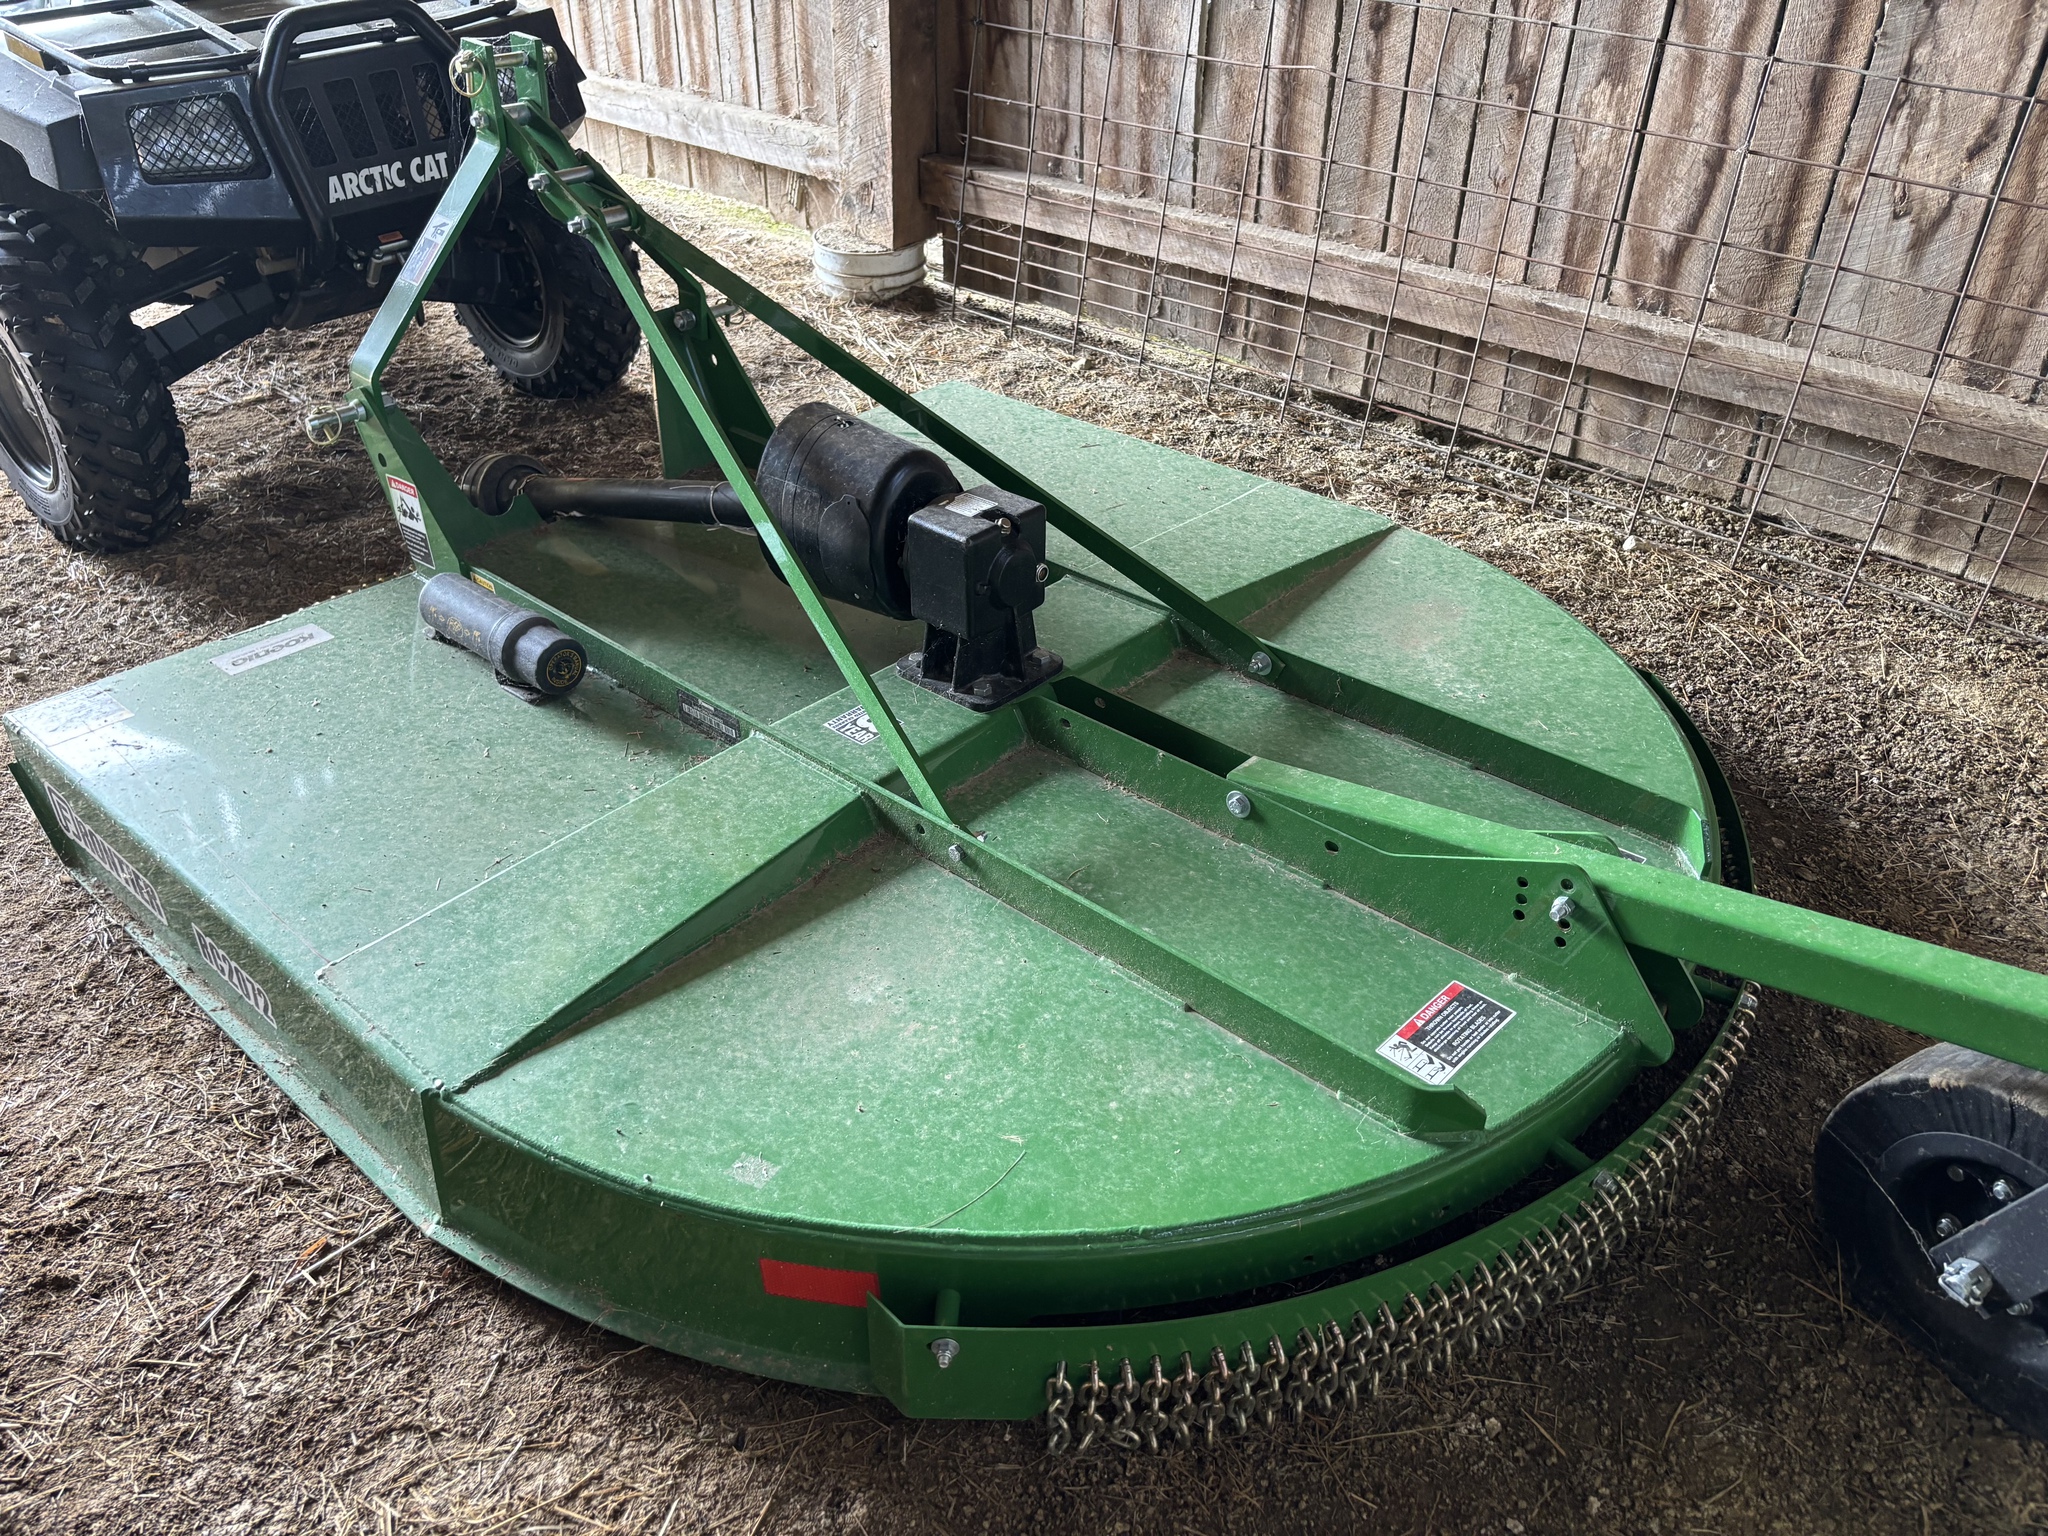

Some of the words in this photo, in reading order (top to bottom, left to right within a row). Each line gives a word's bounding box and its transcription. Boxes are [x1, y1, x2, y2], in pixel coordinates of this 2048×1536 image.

[328, 161, 406, 204] ARCTIC
[409, 151, 449, 184] CAT
[839, 721, 875, 743] YEAR
[48, 784, 166, 922] FRONTIER
[195, 928, 277, 1027] RC2072
[1420, 994, 1451, 1020] DANGER
